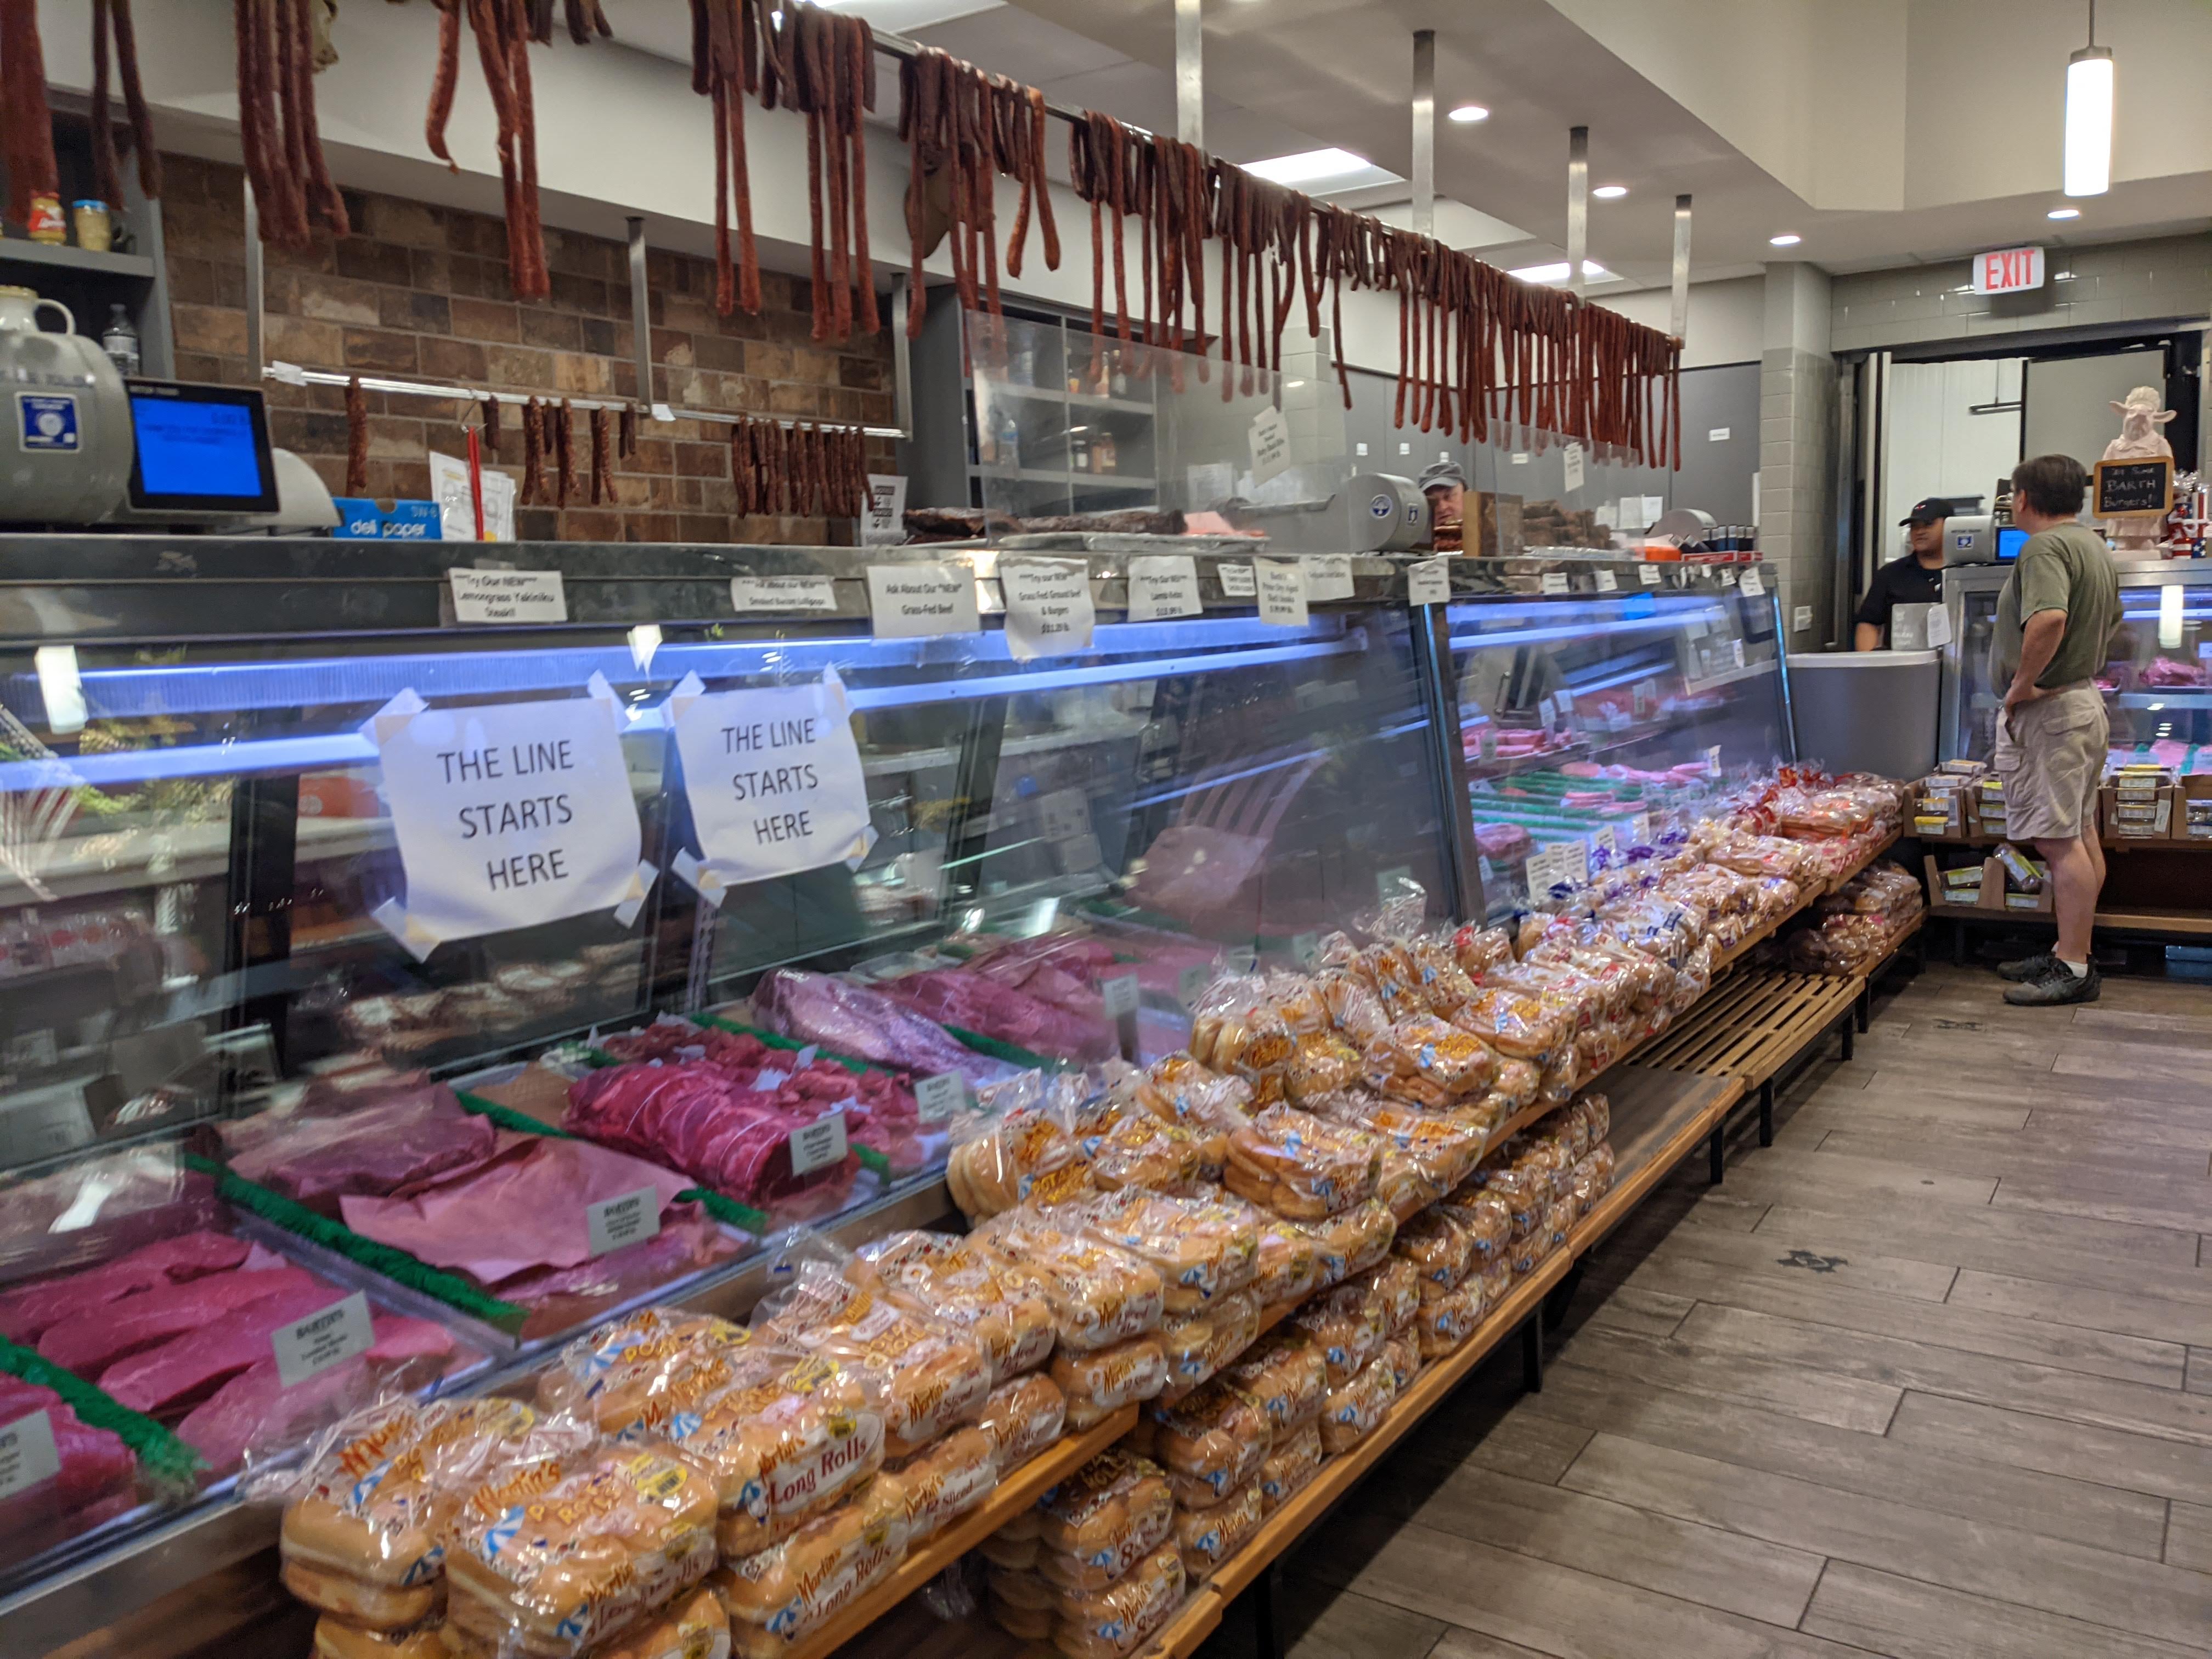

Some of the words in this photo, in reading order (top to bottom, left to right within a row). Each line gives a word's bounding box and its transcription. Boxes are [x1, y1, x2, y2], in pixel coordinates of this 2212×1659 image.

[1985, 250, 2035, 291] EXIT
[2104, 478, 2157, 493] BARTH
[350, 519, 377, 535] deli
[382, 523, 426, 538] paper
[901, 583, 923, 594] About
[721, 726, 764, 755] THE
[770, 717, 816, 748] LINE
[437, 747, 502, 785] THE
[513, 740, 574, 775] LINE
[732, 764, 819, 801] STARTS
[459, 794, 573, 839] STARTS
[754, 810, 814, 845] HERE
[486, 849, 569, 892] HERE
[906, 1378, 950, 1427] Martin's
[942, 1386, 973, 1417] Sliced
[758, 1435, 805, 1487] Martin's
[770, 1468, 817, 1506] Long
[821, 1436, 867, 1479] Rolls
[473, 1460, 561, 1518] Martin's
[906, 1474, 944, 1525] Martin's
[942, 1478, 973, 1504] Sliced
[796, 1547, 842, 1611] Martin's
[816, 1579, 851, 1620] Long
[855, 1544, 891, 1587] Rolls
